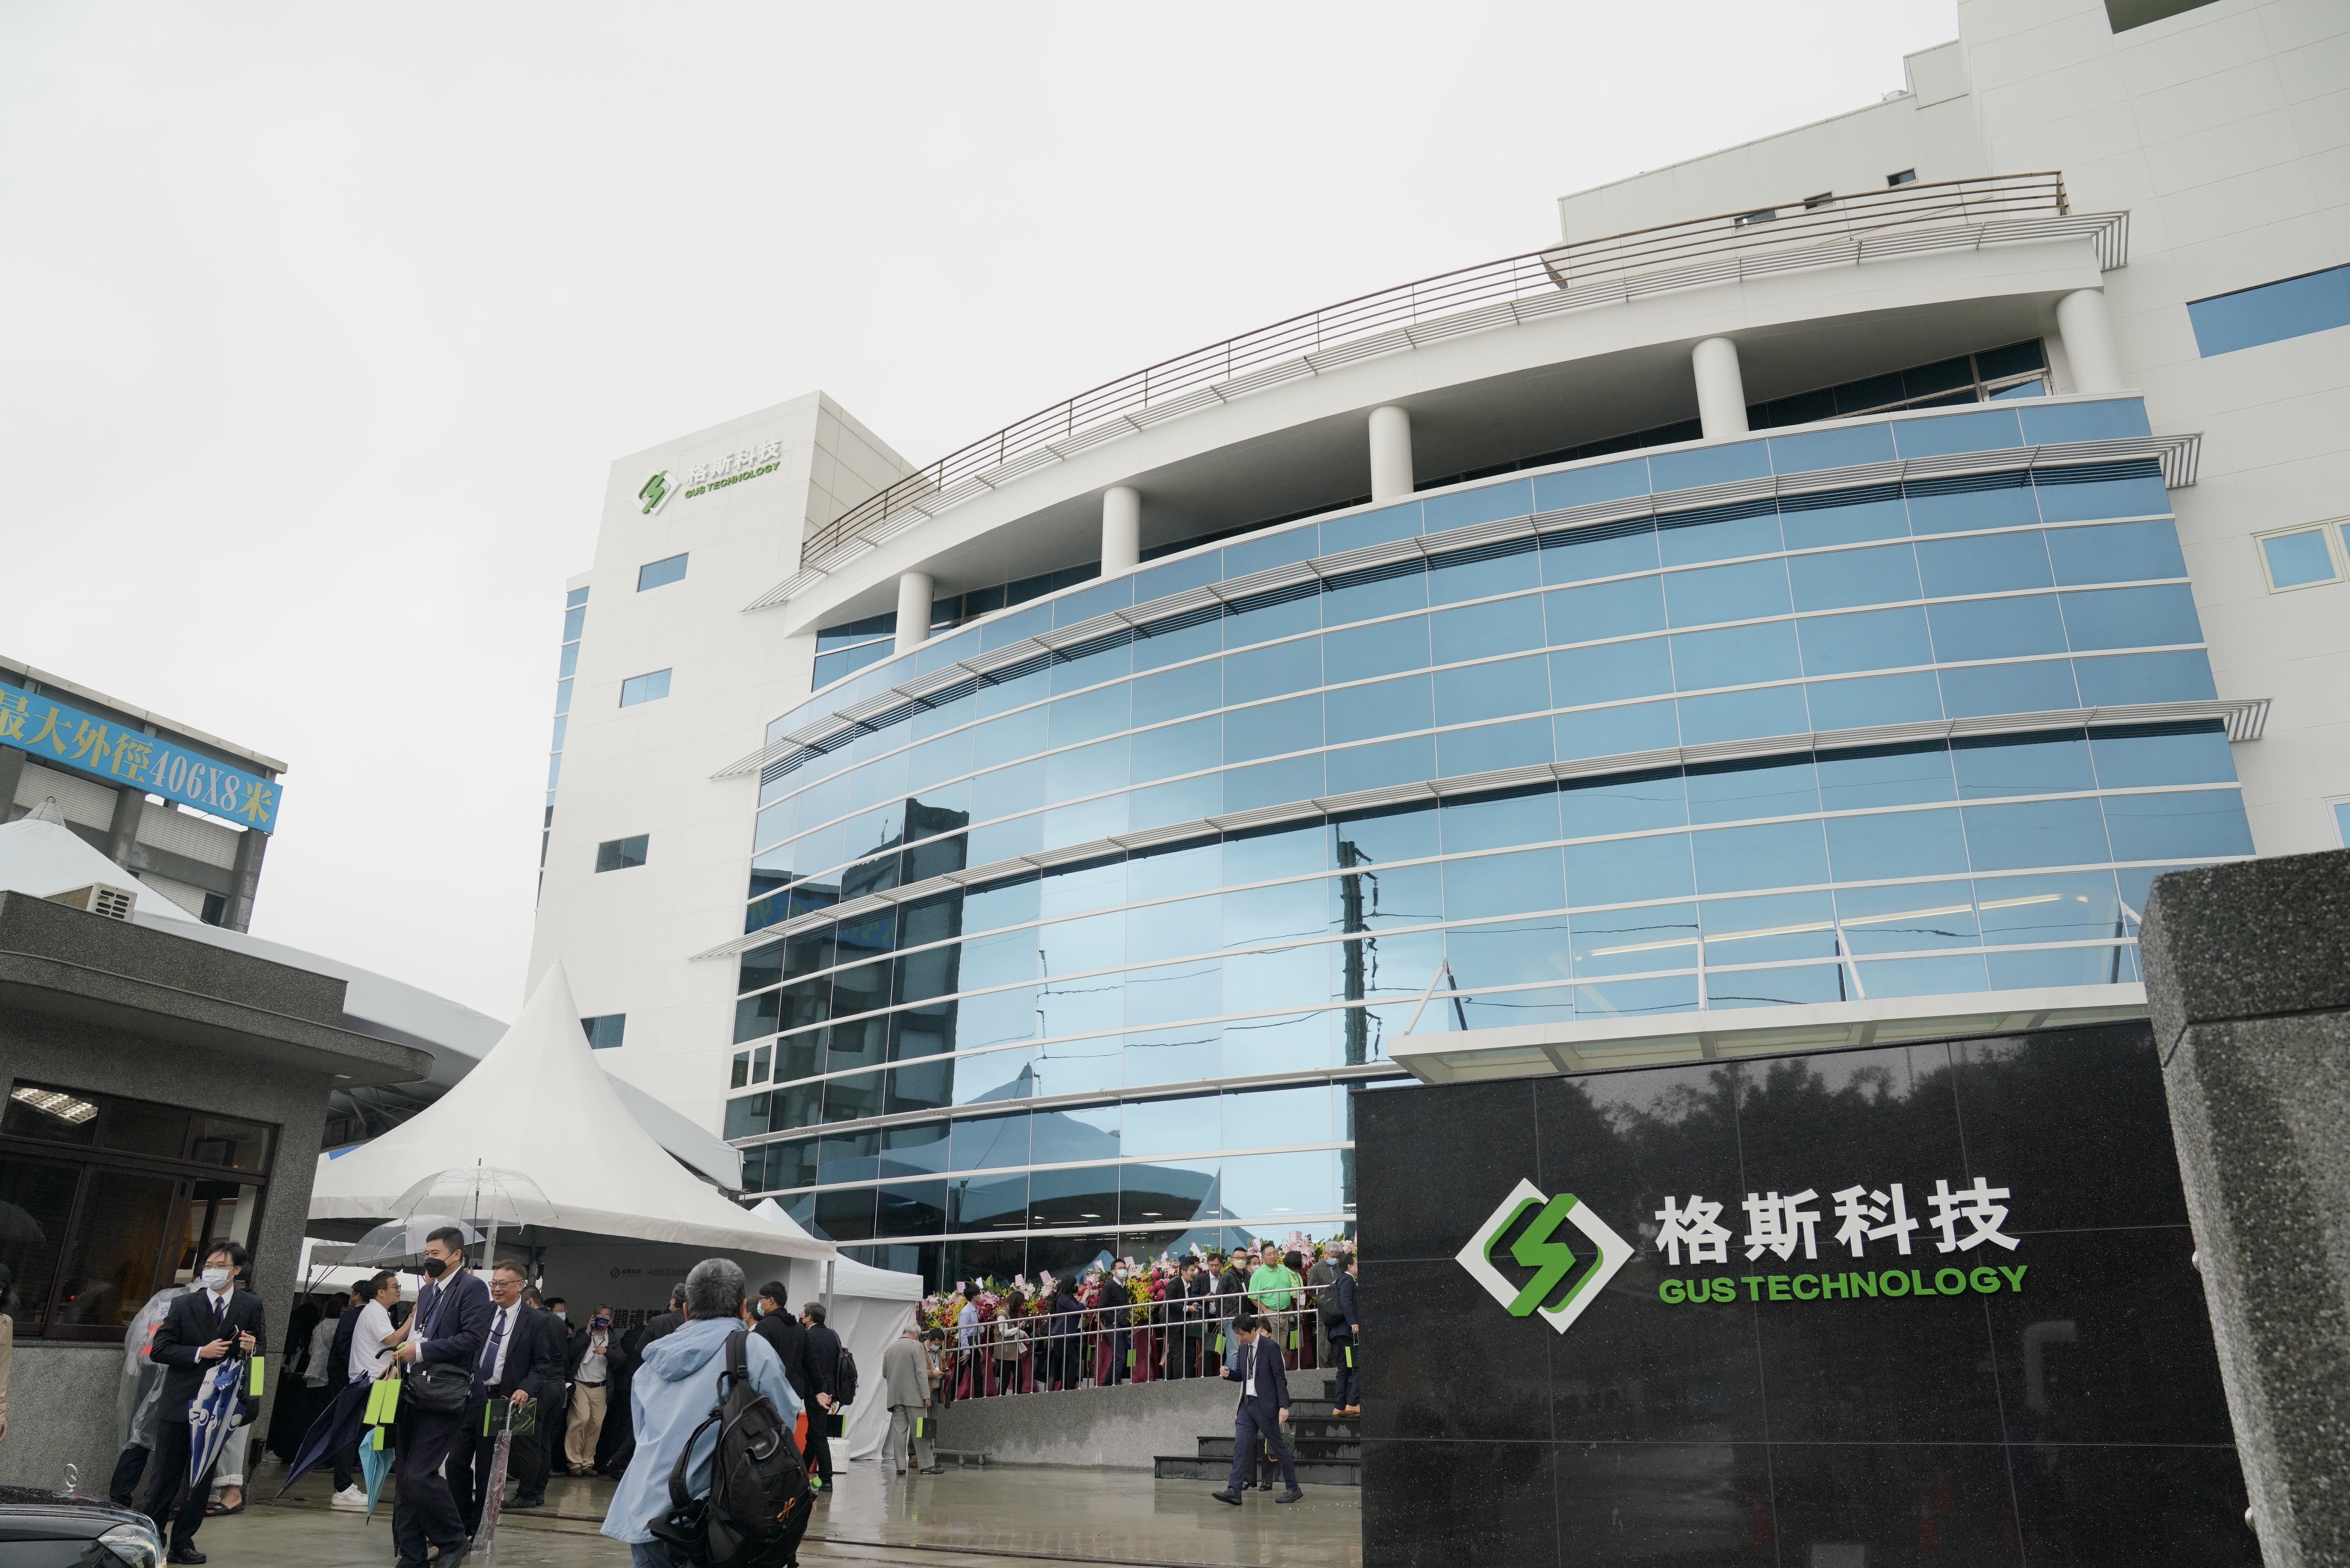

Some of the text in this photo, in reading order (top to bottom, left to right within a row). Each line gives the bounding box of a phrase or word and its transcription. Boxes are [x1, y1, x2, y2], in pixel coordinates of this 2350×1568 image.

[684, 461, 781, 498] GUS TECHNOLOGY
[686, 437, 782, 486] 格斯科技
[1655, 1177, 2020, 1265] 格斯科技
[1659, 1265, 2029, 1304] GUS TECHNOLOGY
